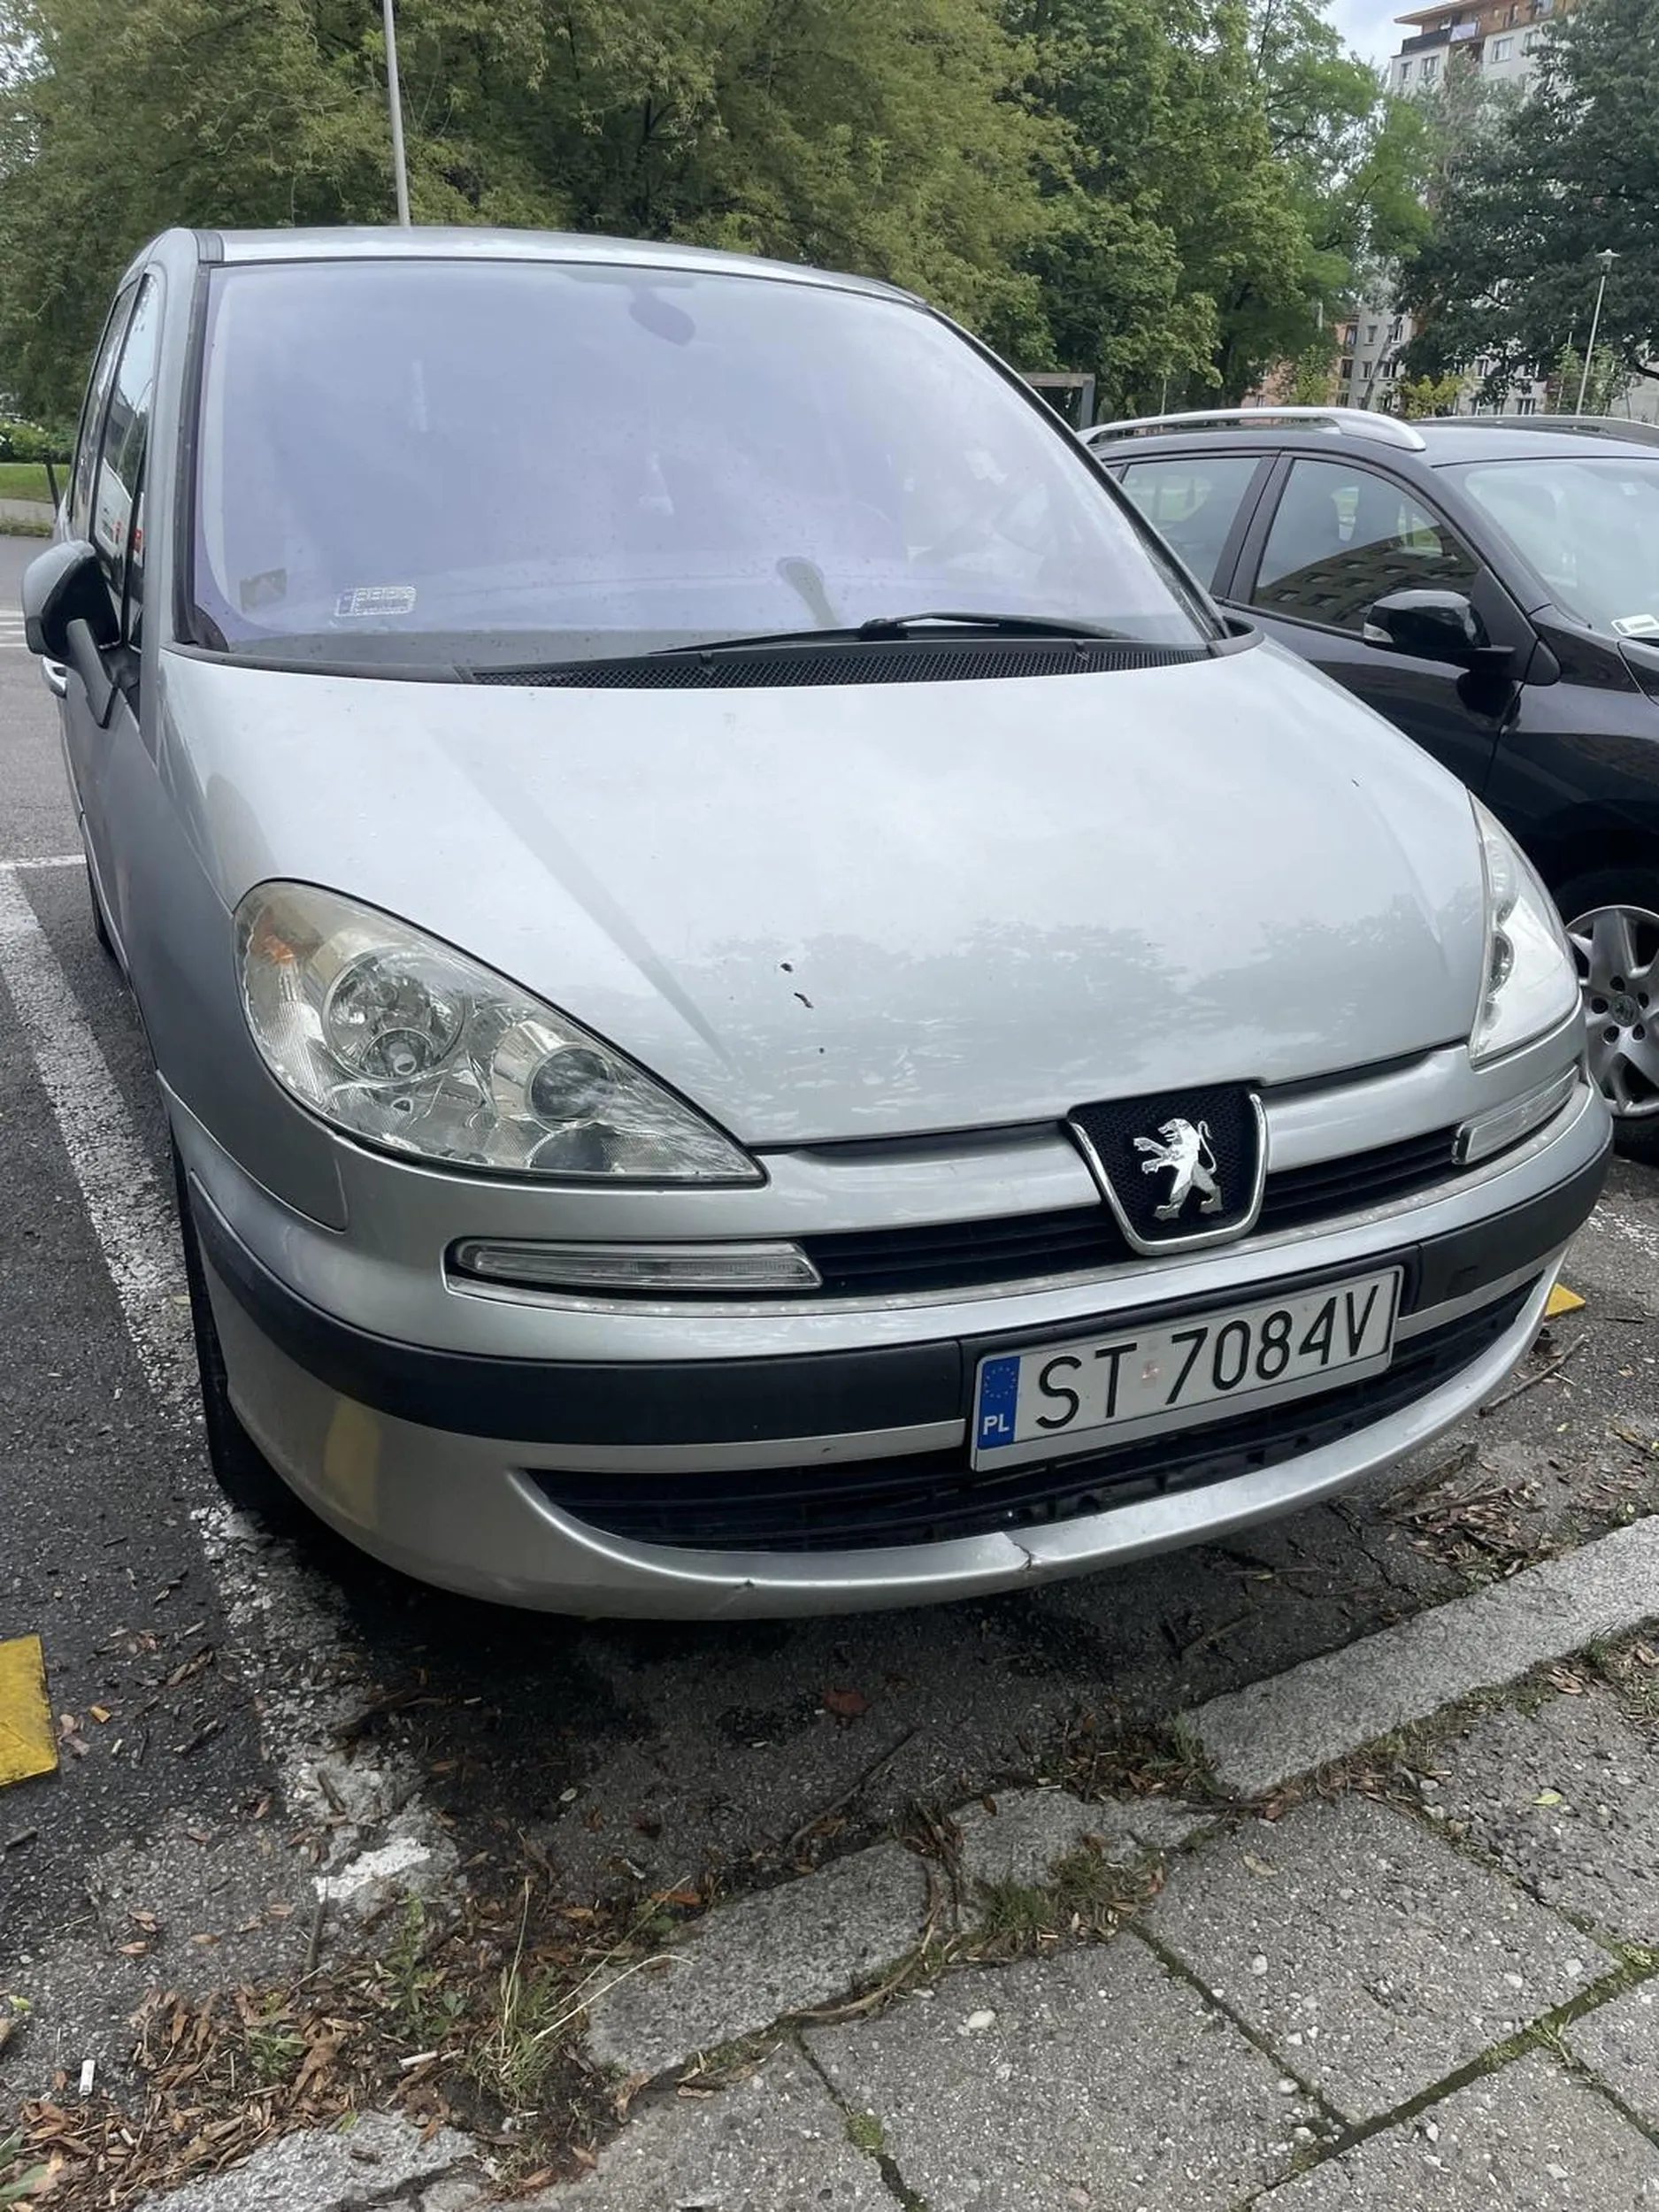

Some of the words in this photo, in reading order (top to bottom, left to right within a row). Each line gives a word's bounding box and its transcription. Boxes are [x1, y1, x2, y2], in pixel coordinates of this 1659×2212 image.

[1036, 1342, 1138, 1429] ST
[1165, 1284, 1379, 1405] 7084V
[983, 1415, 1010, 1435] PL
